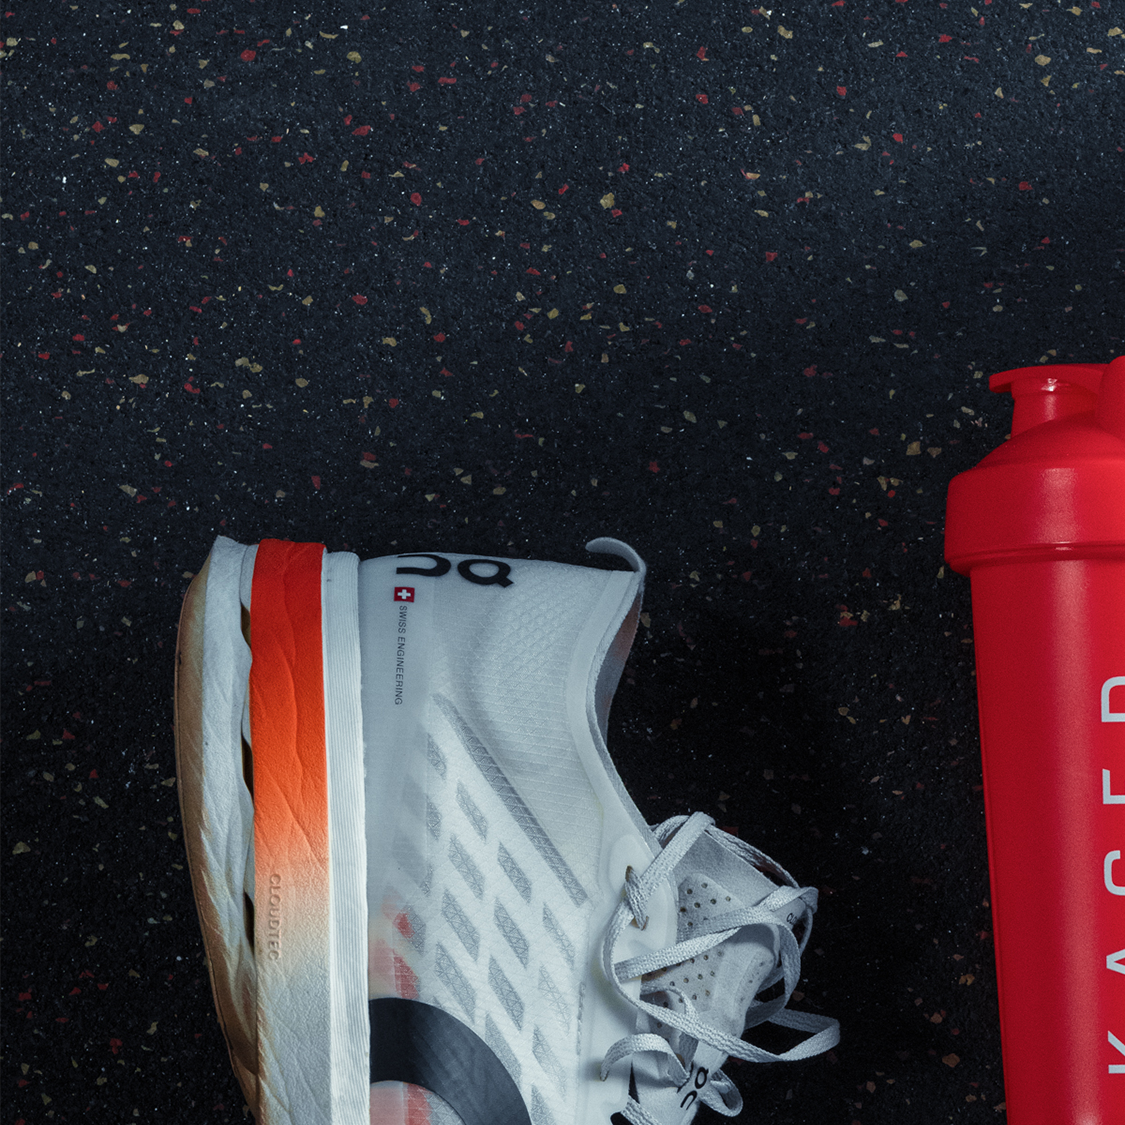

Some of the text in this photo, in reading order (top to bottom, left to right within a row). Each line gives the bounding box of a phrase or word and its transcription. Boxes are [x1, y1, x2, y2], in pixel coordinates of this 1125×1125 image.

[394, 605, 408, 705] SWISS ENGINEERING
[268, 873, 282, 961] CLOUDTEC
